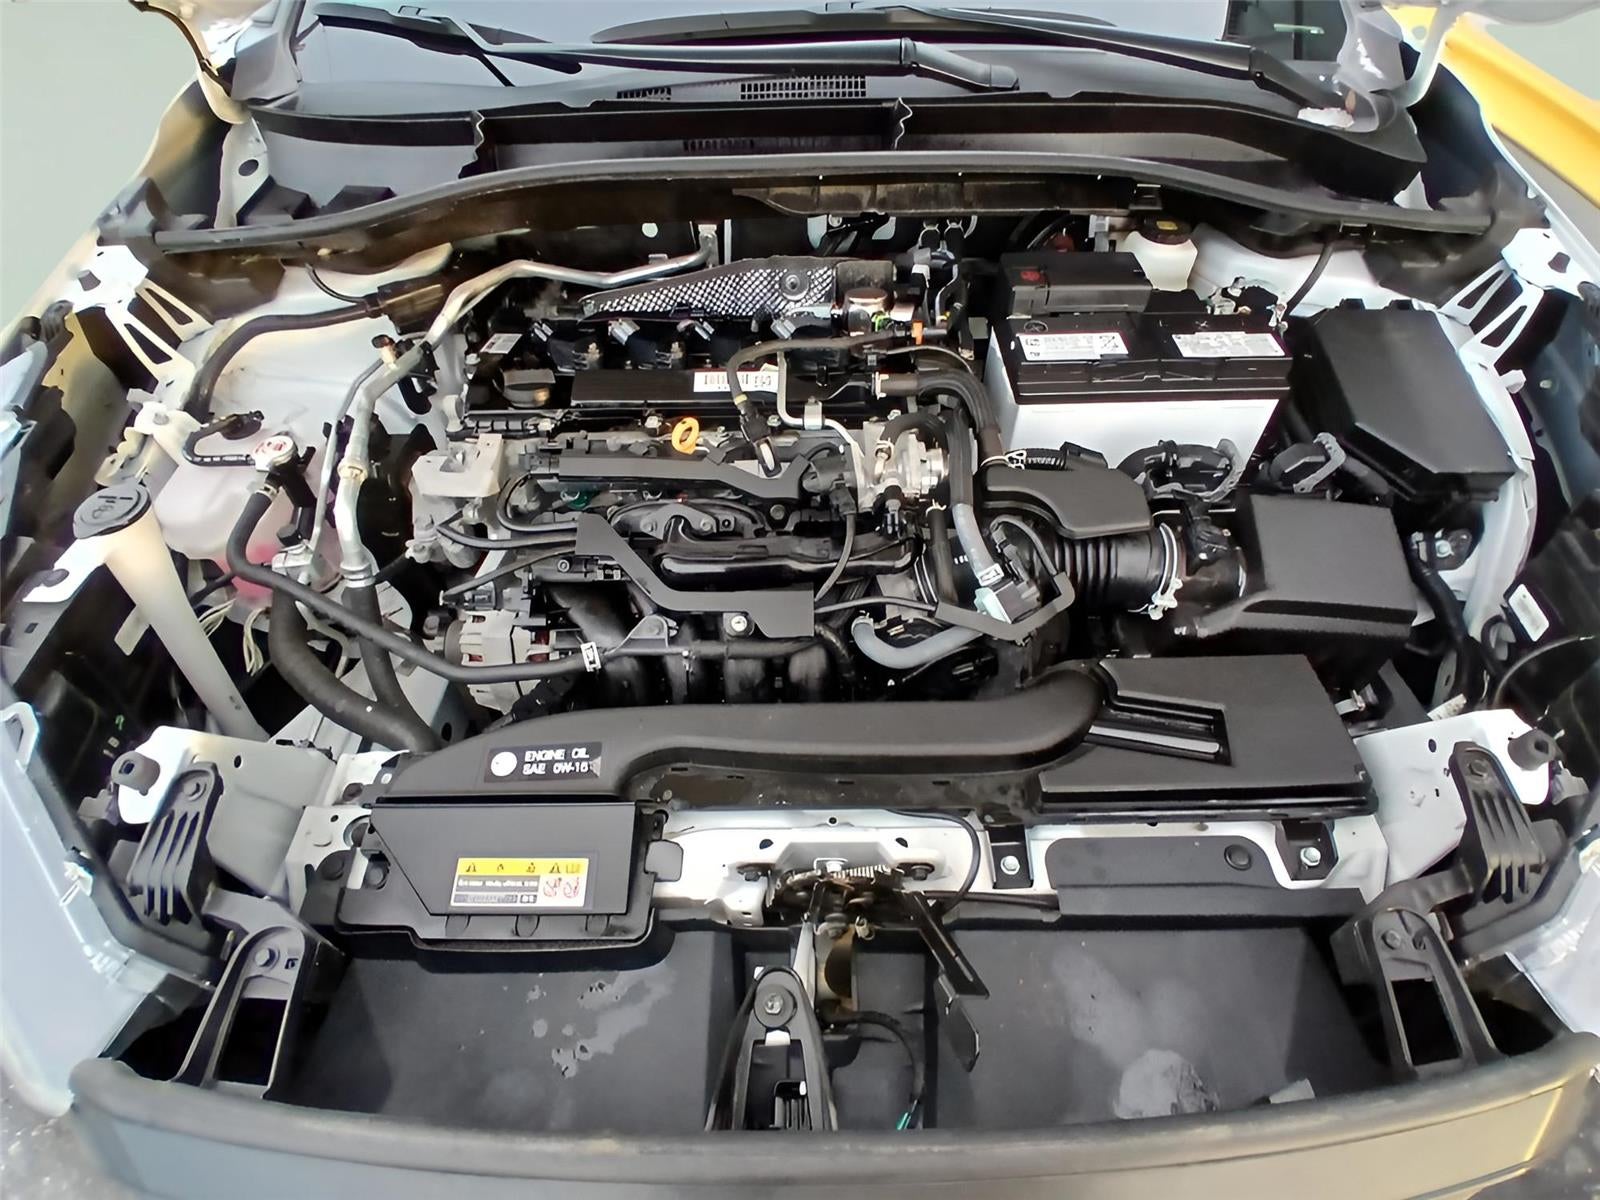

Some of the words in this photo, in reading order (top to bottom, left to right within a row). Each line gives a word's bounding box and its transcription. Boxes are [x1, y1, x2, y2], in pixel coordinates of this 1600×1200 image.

[524, 749, 566, 762] ENGINE
[571, 747, 590, 759] OIL
[522, 763, 546, 775] SAE
